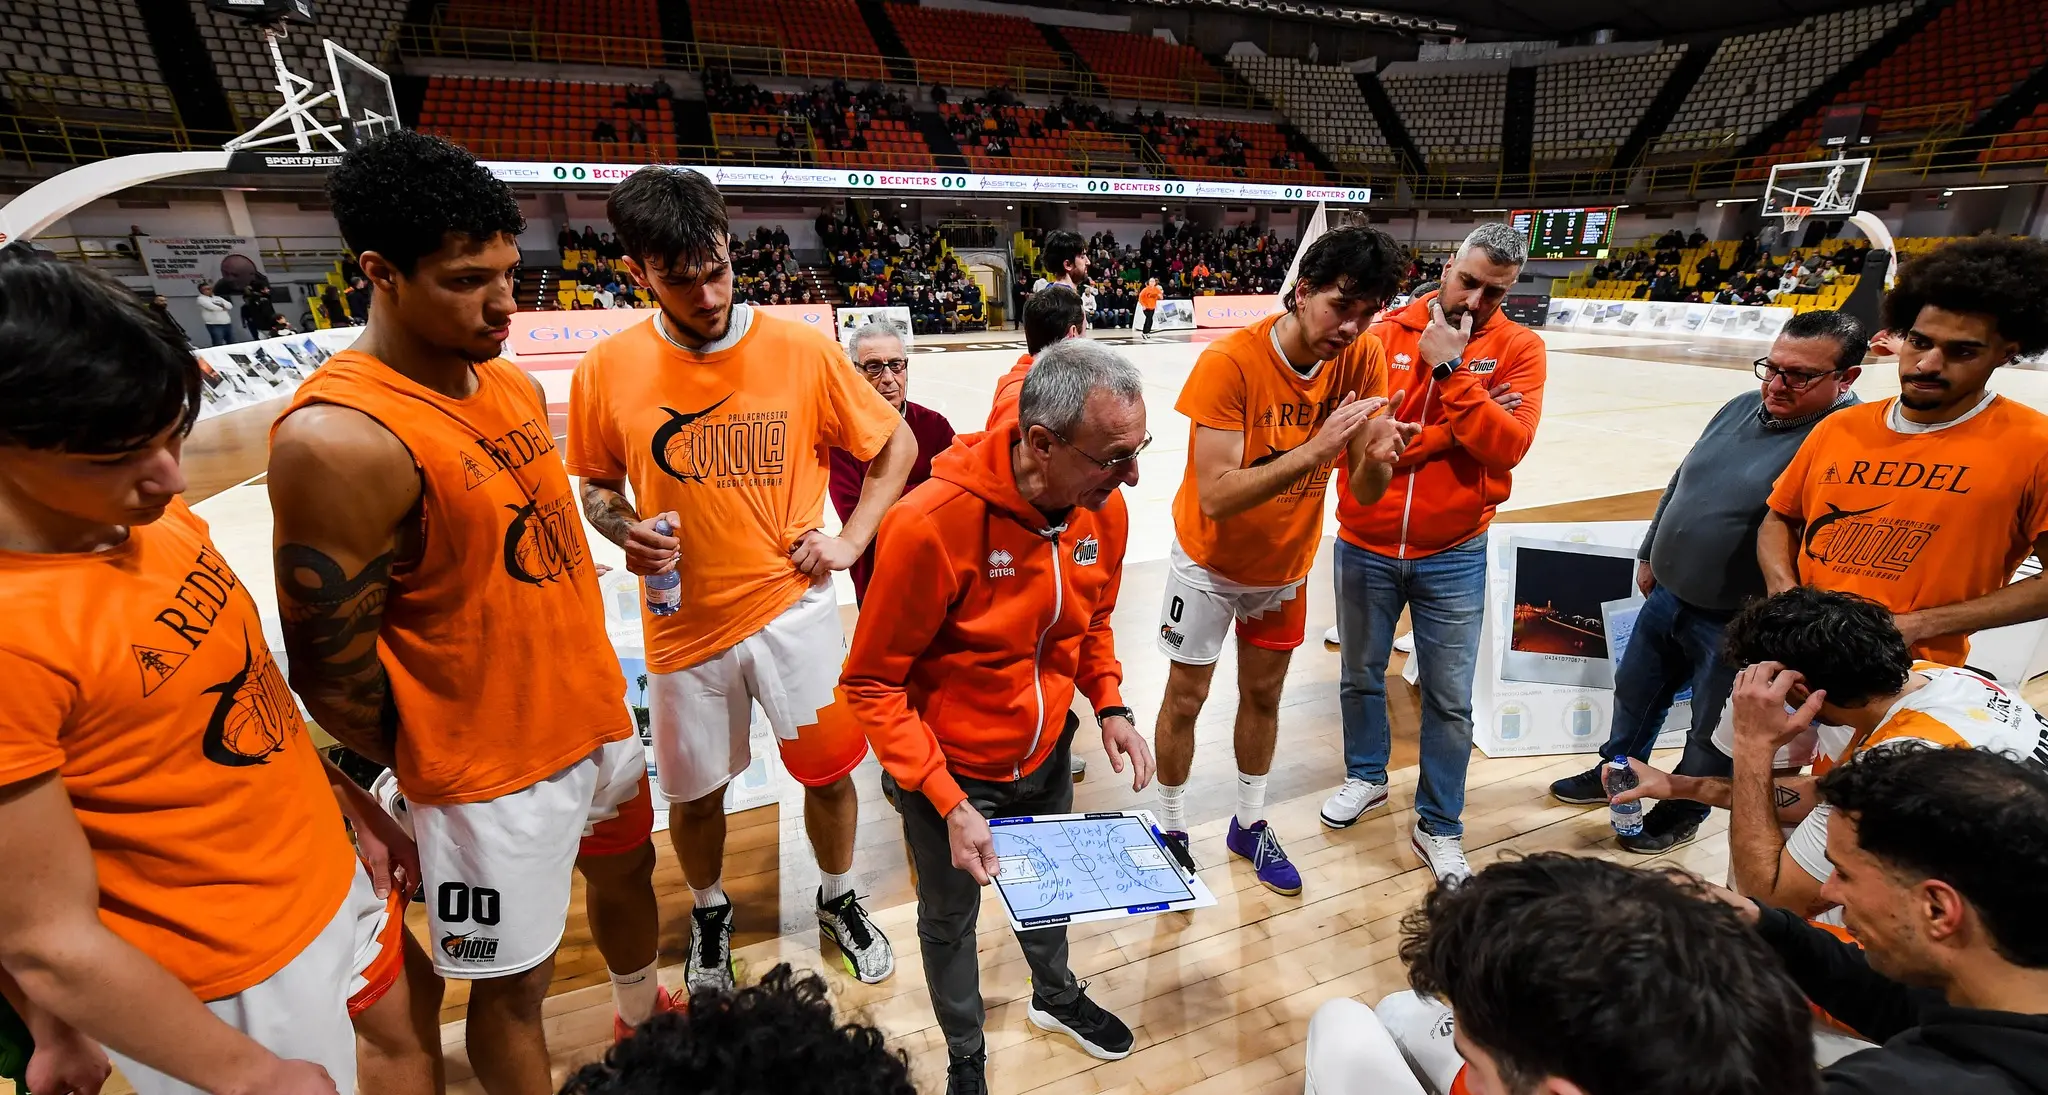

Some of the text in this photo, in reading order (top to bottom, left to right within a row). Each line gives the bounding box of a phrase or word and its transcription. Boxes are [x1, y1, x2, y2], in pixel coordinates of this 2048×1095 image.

[593, 168, 636, 179] BCENT
[880, 176, 937, 186] BCENTERS
[1113, 183, 1160, 191] BCENTERS
[1306, 190, 1345, 198] BCENTERS
[1475, 361, 1496, 372] VIOLA
[475, 419, 555, 472] REDEL
[691, 420, 786, 479] VIOLA
[717, 477, 783, 489] REGGIO CALABRIA
[1846, 460, 1972, 494] REDEL
[1080, 543, 1098, 561] VIOLA
[1824, 522, 1932, 573] VIOLA
[1170, 595, 1184, 623] 0
[438, 882, 500, 926] 00
[1025, 918, 1051, 926] Coaching
[456, 940, 498, 958] VIOLA
